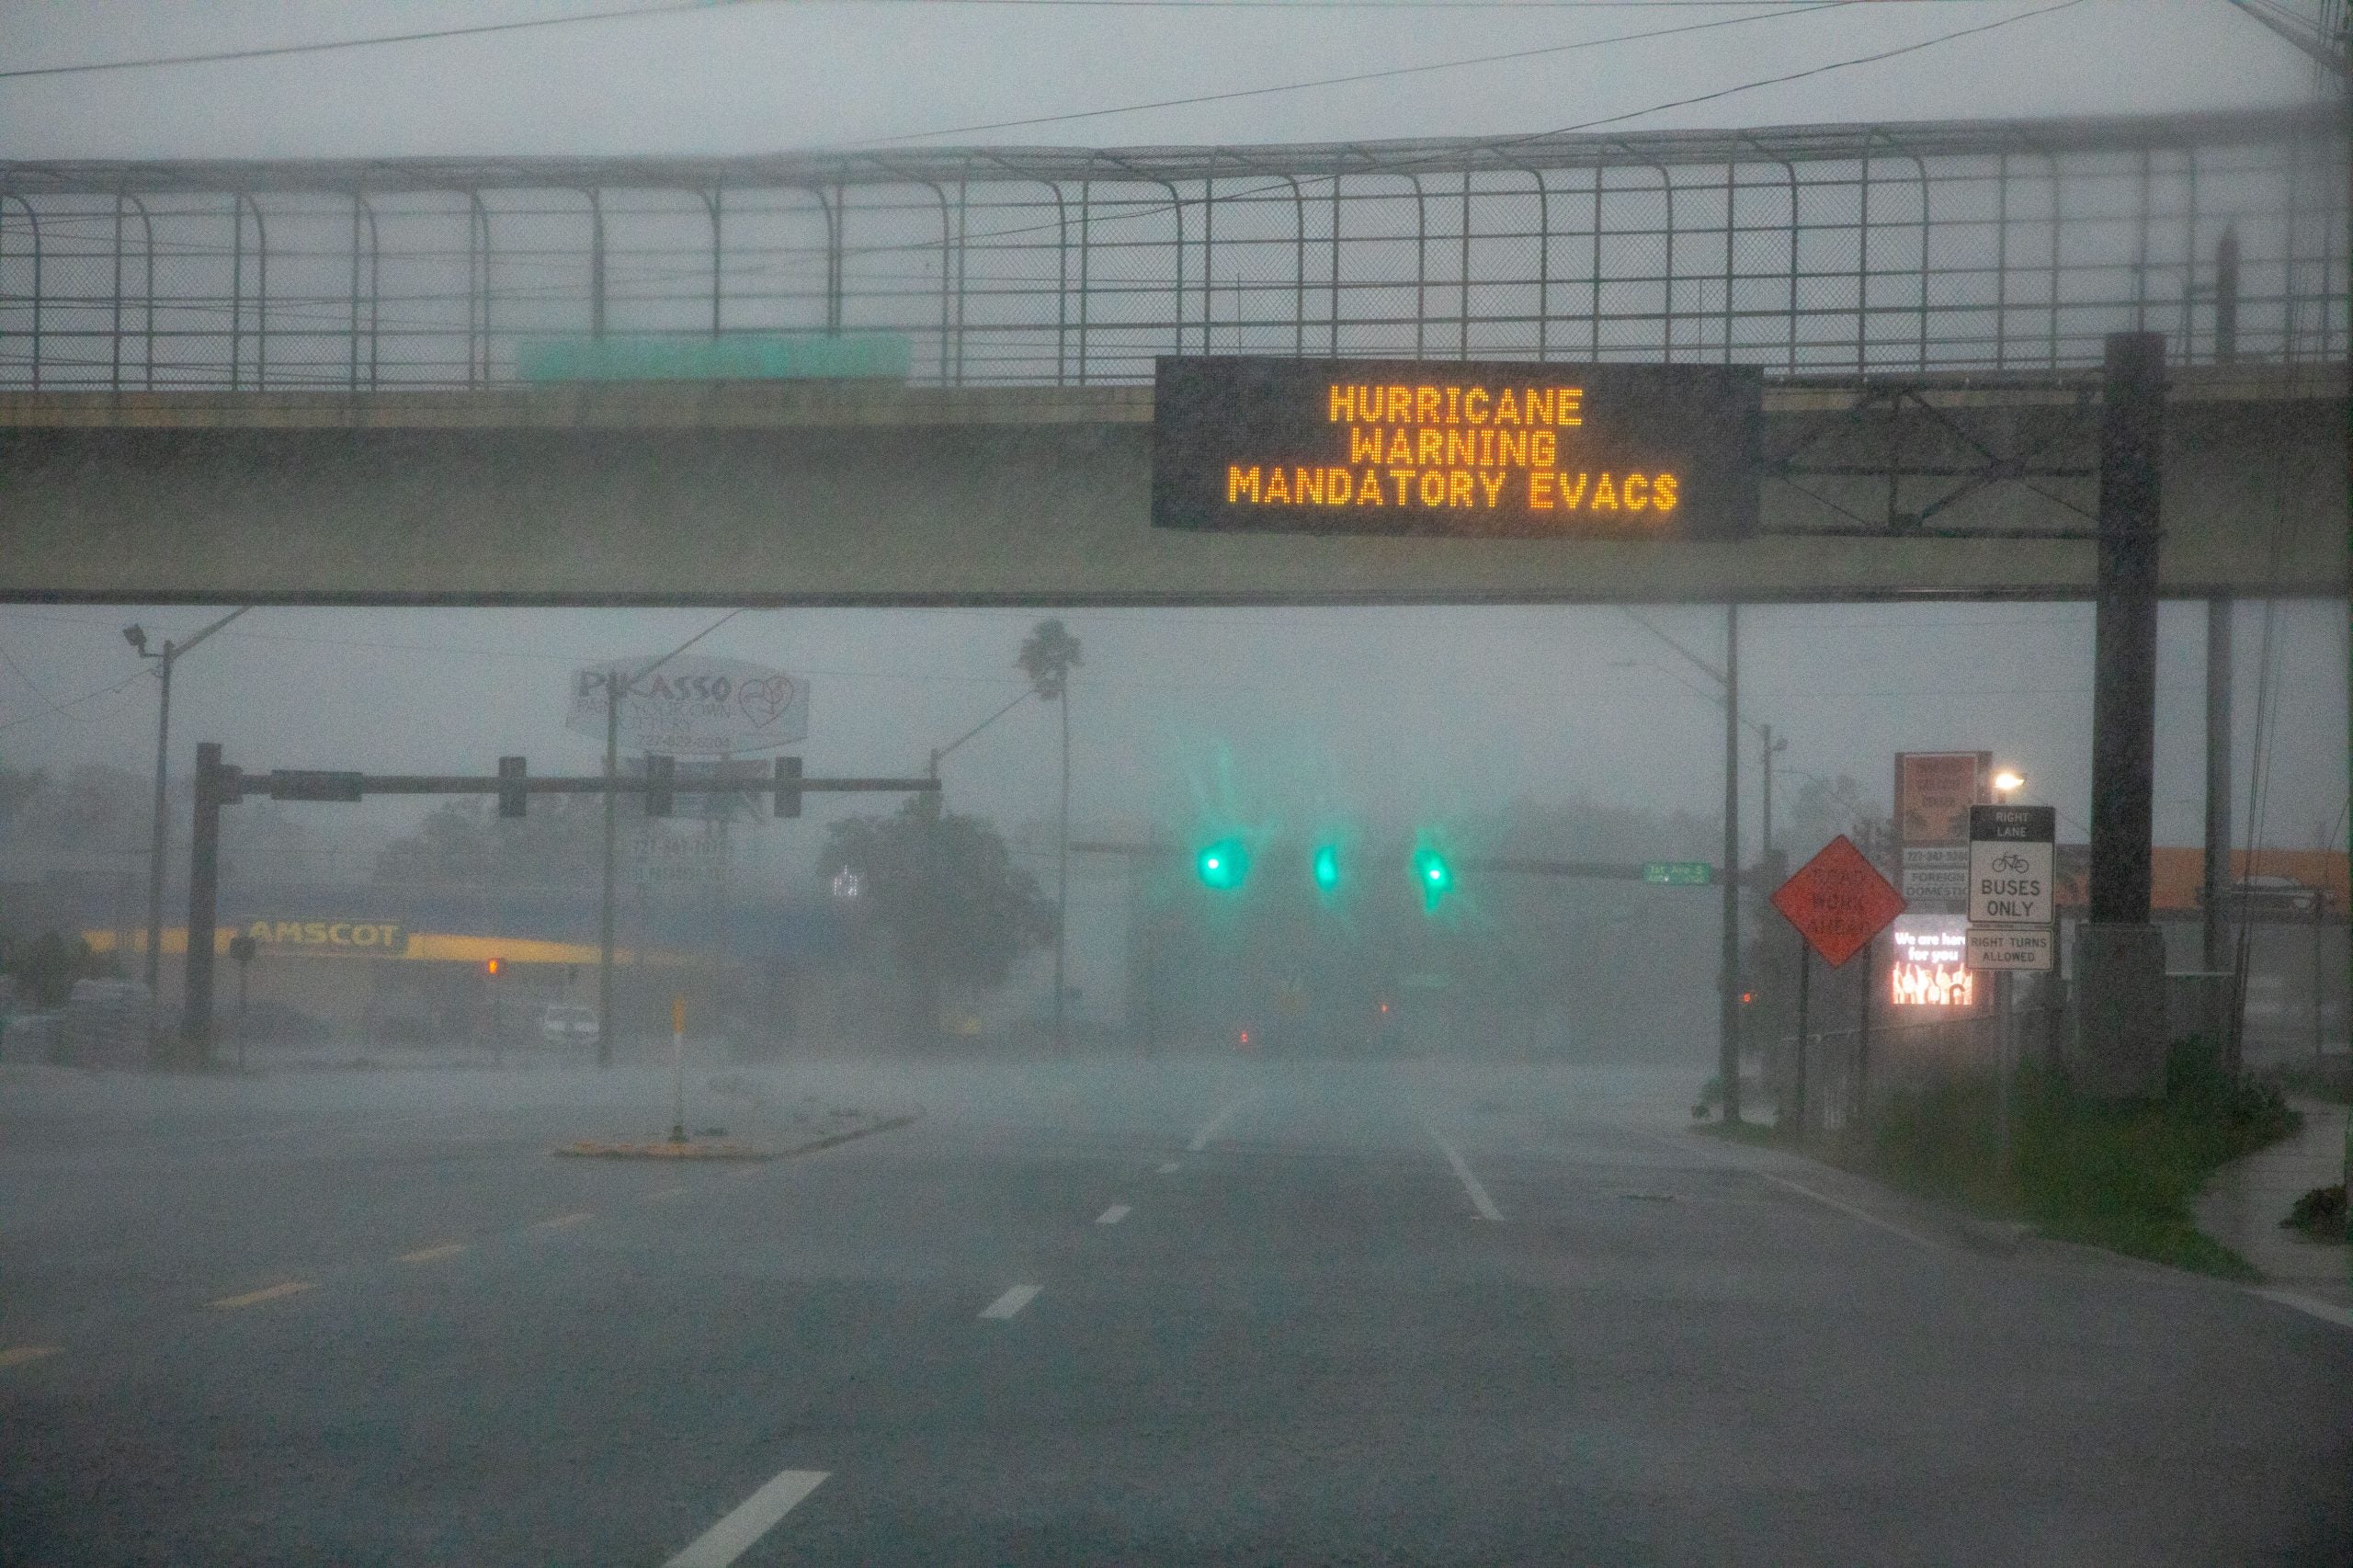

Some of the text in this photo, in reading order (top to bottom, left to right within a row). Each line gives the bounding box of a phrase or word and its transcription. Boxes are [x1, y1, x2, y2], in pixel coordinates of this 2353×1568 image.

[1329, 384, 1584, 426] HURRICANE
[1350, 427, 1557, 467] WARNING
[1227, 466, 1679, 512] MANDATORY EVACS
[578, 670, 732, 702] PKASSO
[577, 699, 623, 716] PAIT
[1995, 811, 2029, 824] RIGHT
[1996, 826, 2028, 838] LANE
[1912, 872, 1965, 882] FOREIGN
[1981, 879, 2040, 896] BUSES
[1986, 900, 2035, 916] ONLY
[248, 921, 400, 948] AMSCOT
[1894, 931, 1916, 946] We
[1917, 935, 1939, 946] are
[1971, 937, 2047, 949] RIGHT TURNS
[1908, 946, 1959, 964] for you
[1983, 950, 2036, 963] ALLOWED
